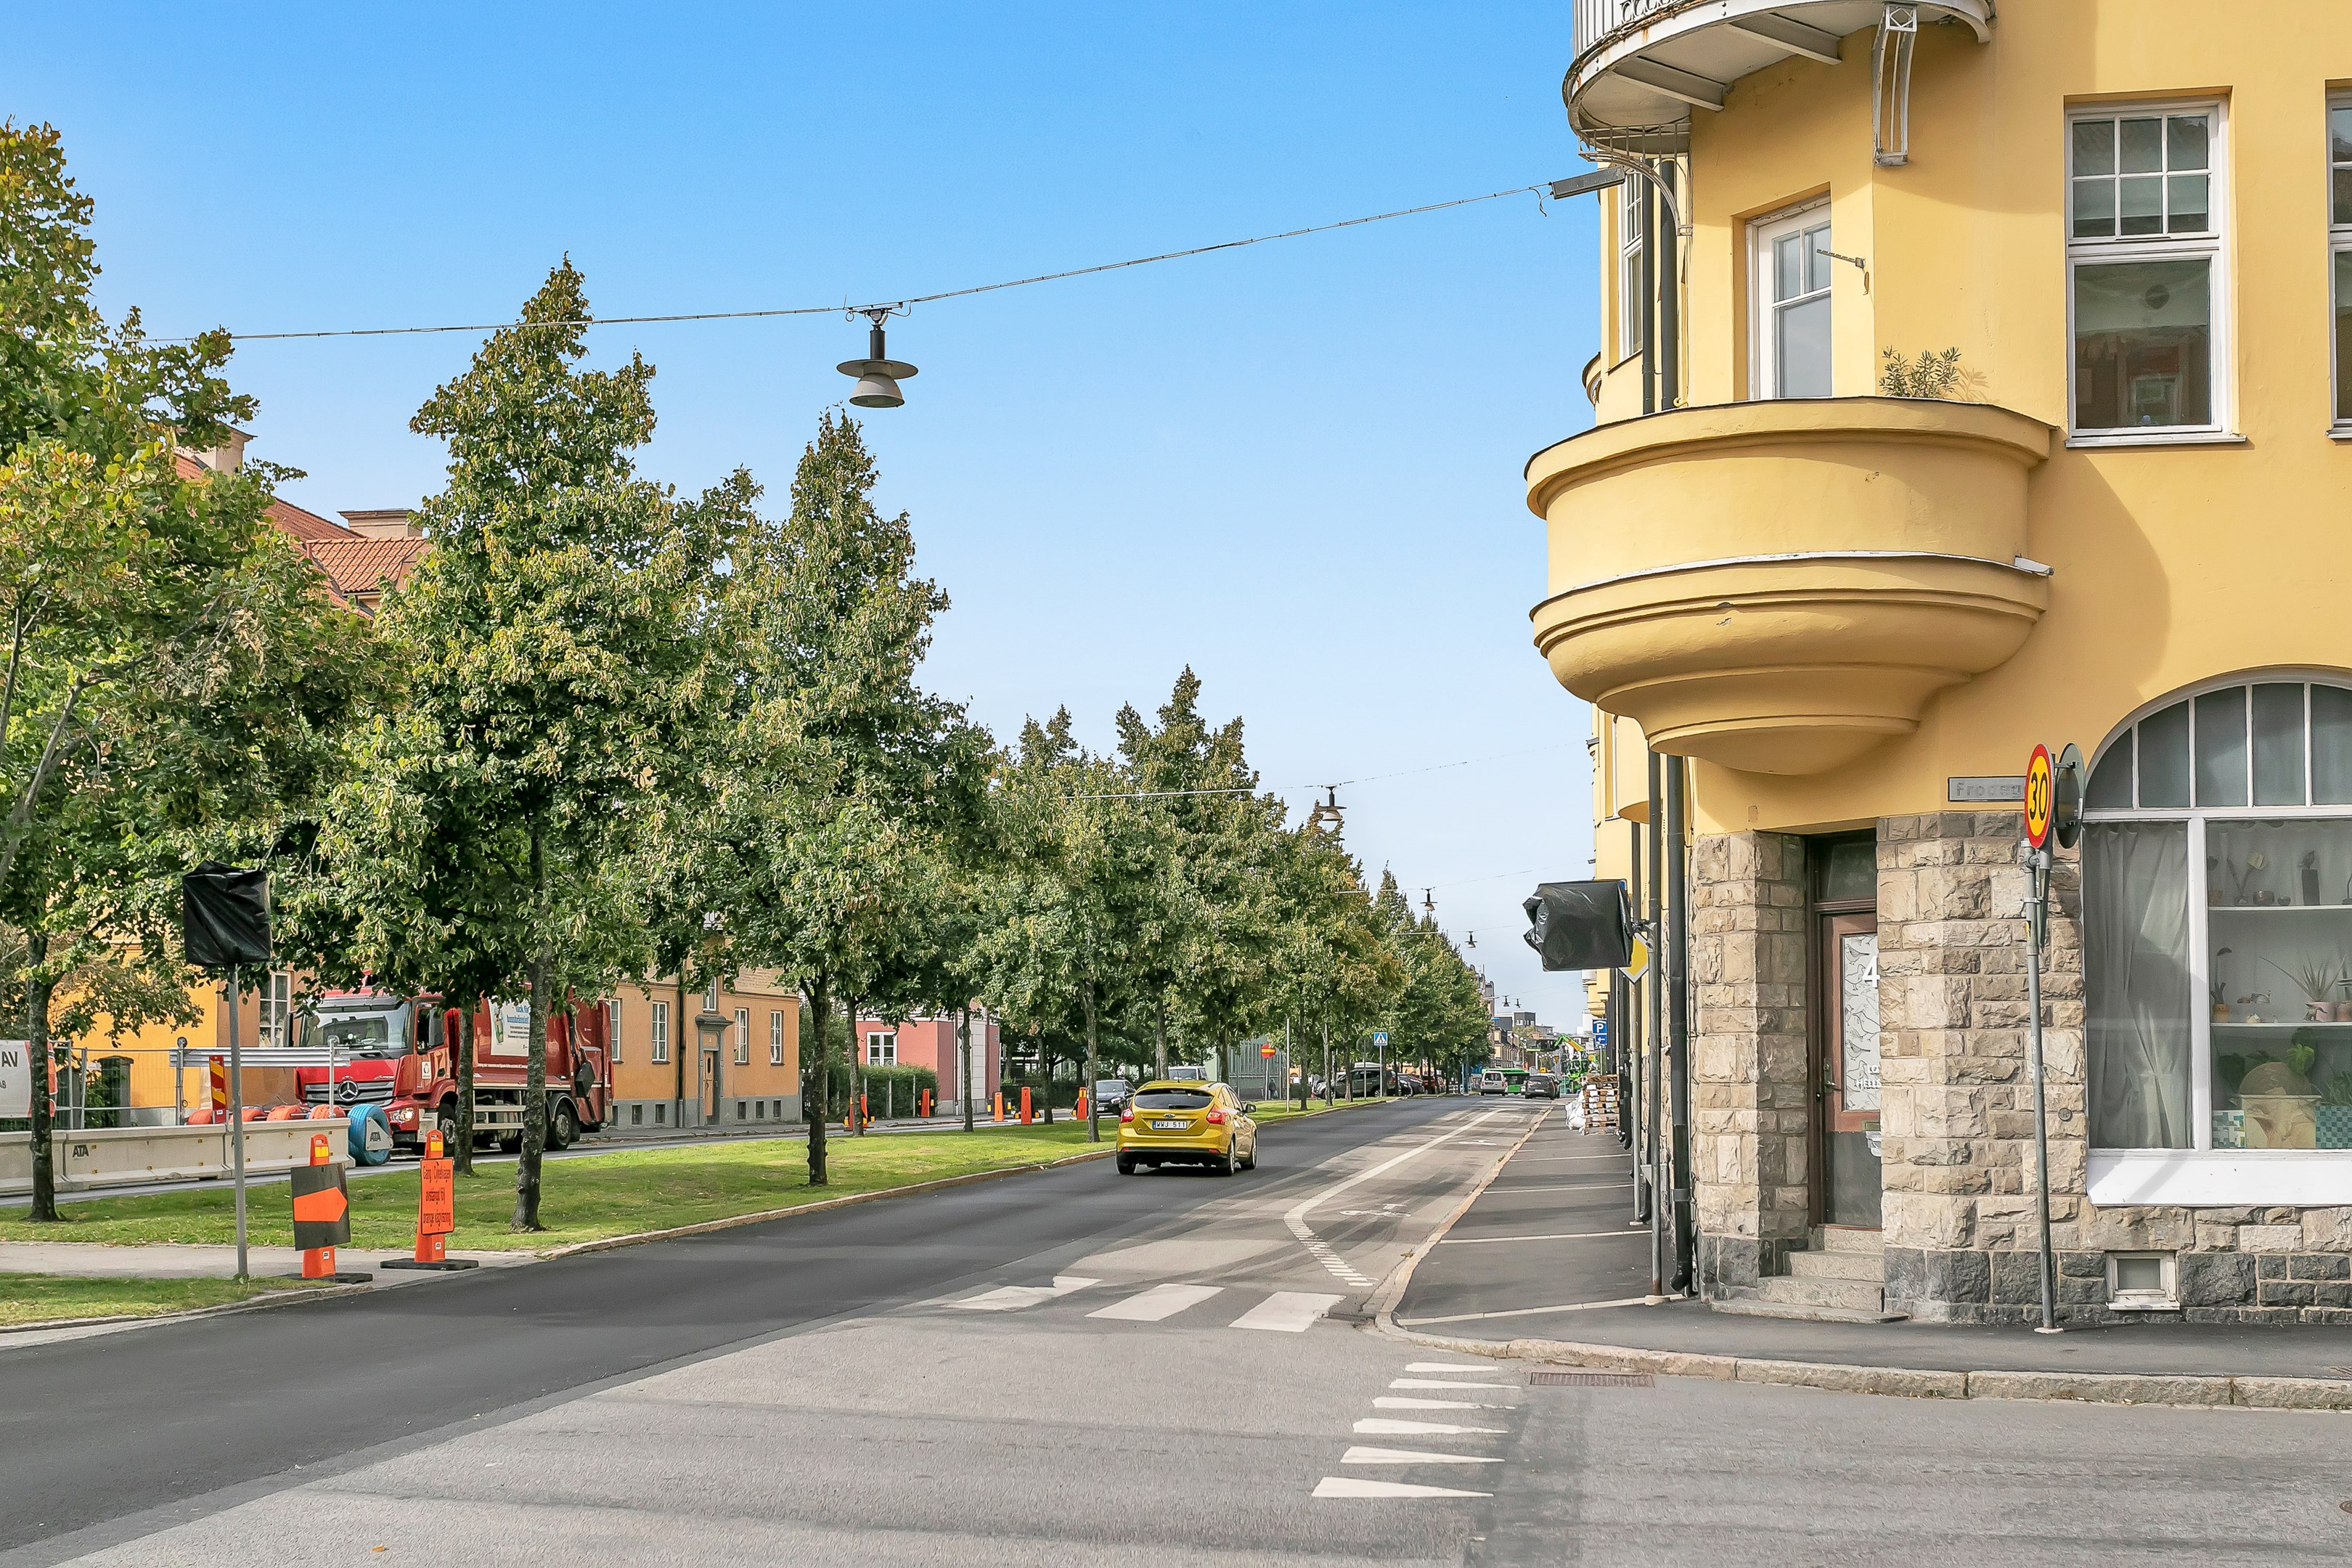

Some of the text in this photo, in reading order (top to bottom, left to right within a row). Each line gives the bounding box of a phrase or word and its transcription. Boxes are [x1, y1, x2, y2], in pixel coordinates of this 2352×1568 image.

[1956, 782, 2021, 799] Frodeg
[2030, 772, 2048, 821] 30
[1596, 1023, 1604, 1033] P
[1867, 1064, 1880, 1074] LO
[1856, 1079, 1882, 1089] HELLS
[369, 1132, 381, 1141] ATA
[73, 1144, 89, 1157] ATA
